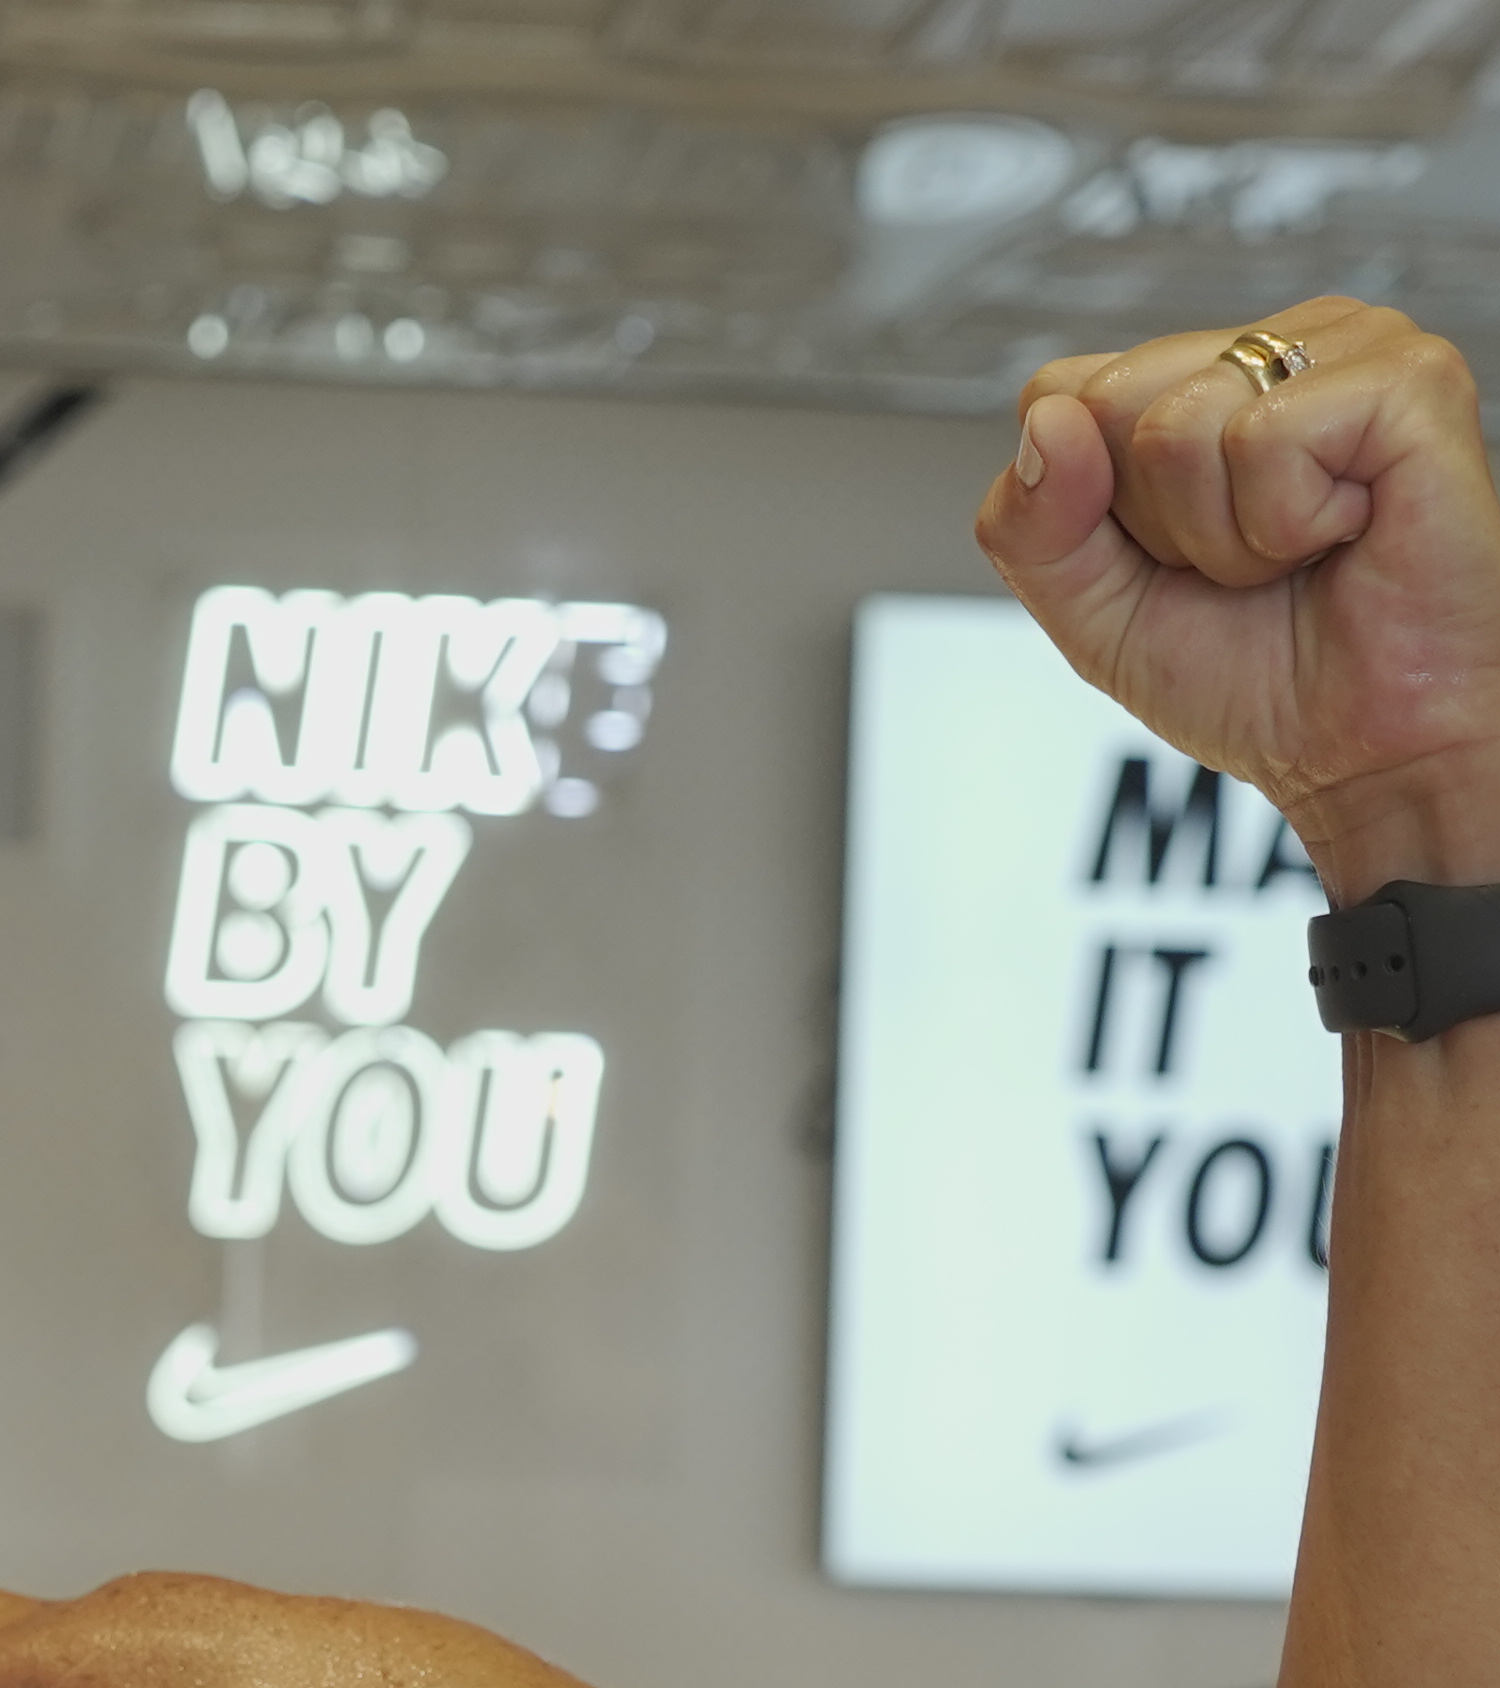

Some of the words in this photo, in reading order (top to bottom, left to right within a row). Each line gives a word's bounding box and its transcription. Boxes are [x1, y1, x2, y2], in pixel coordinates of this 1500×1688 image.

[163, 804, 474, 1028] BY
[1082, 938, 1214, 1076] IT
[172, 1021, 606, 1252] YOU
